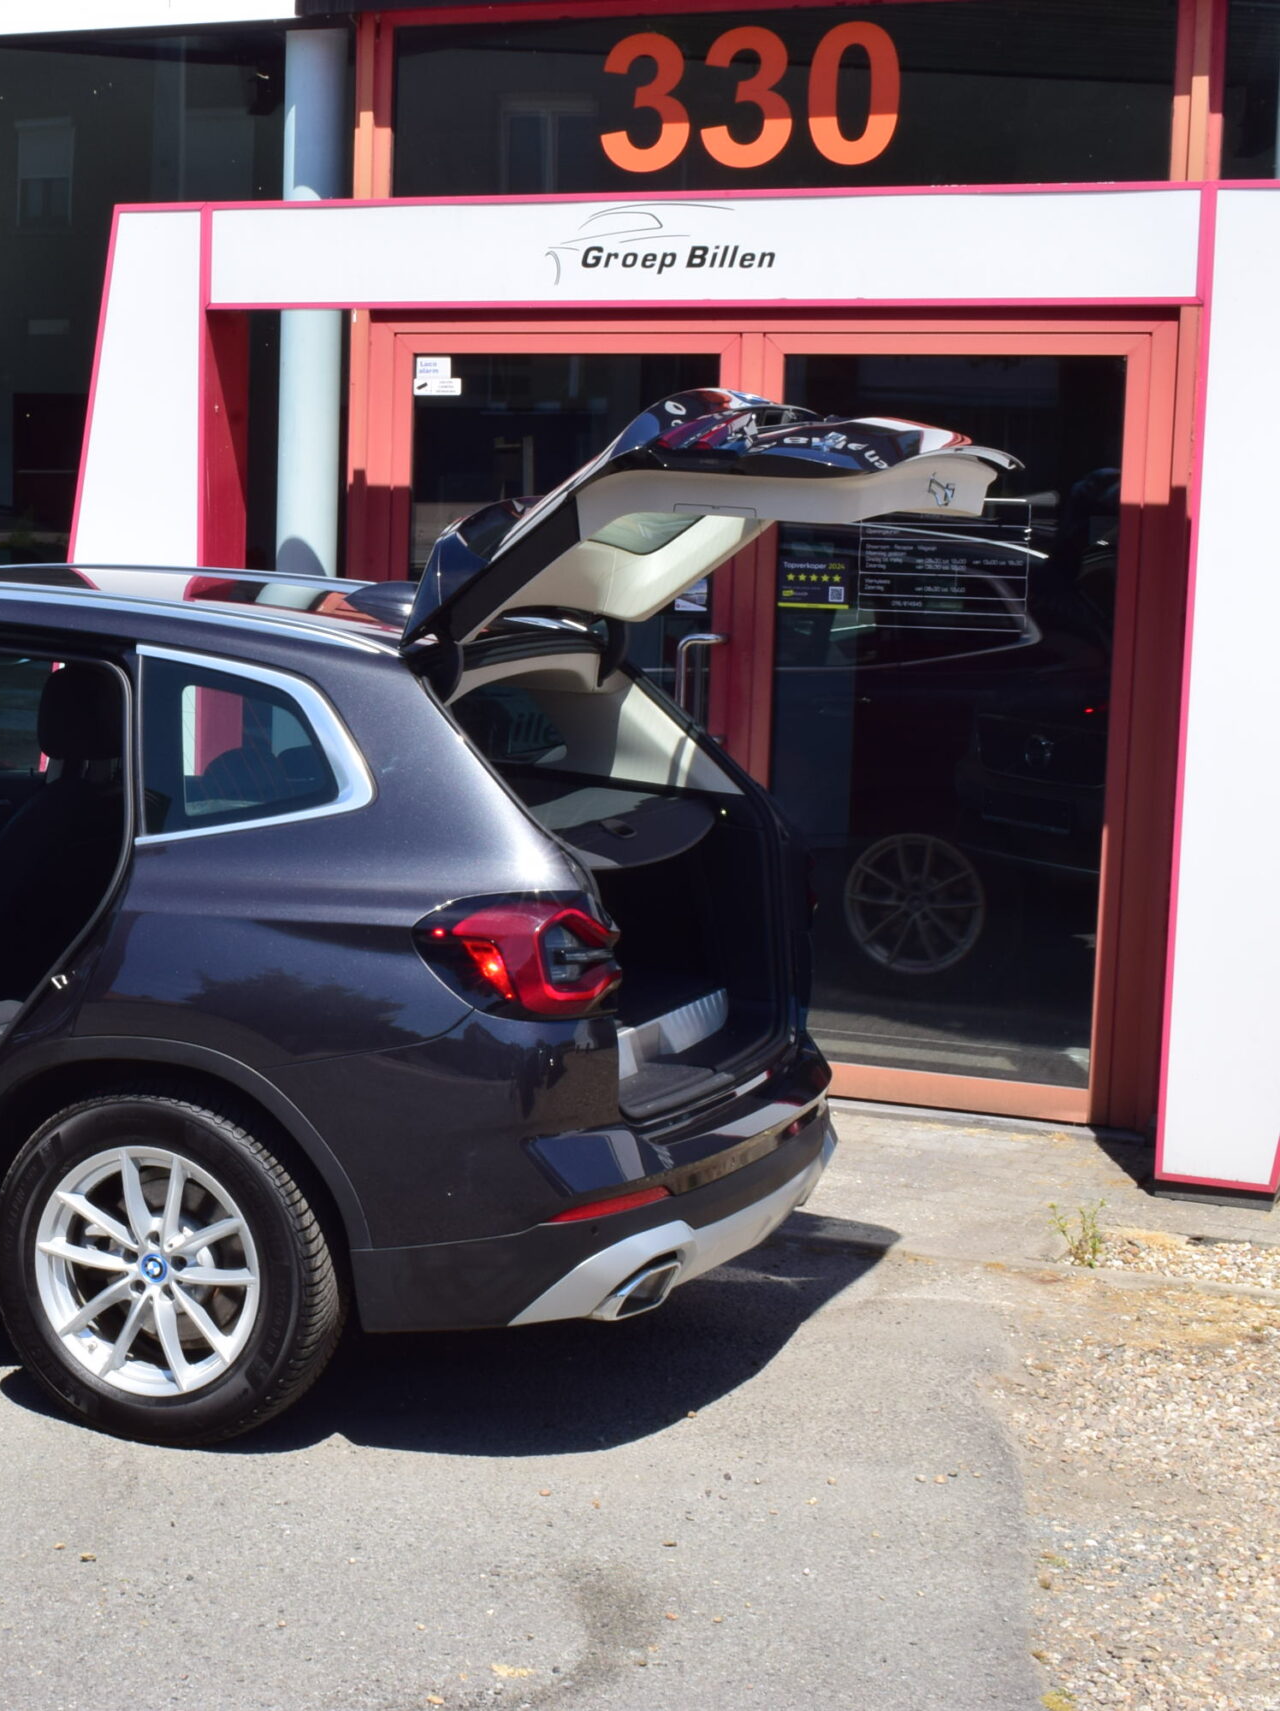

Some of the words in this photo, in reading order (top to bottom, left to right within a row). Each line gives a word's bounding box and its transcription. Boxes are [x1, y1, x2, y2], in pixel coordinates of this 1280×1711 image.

[600, 20, 901, 173] 330
[580, 245, 677, 274] Groep
[686, 245, 776, 269] Billen
[828, 562, 846, 570] 2024
